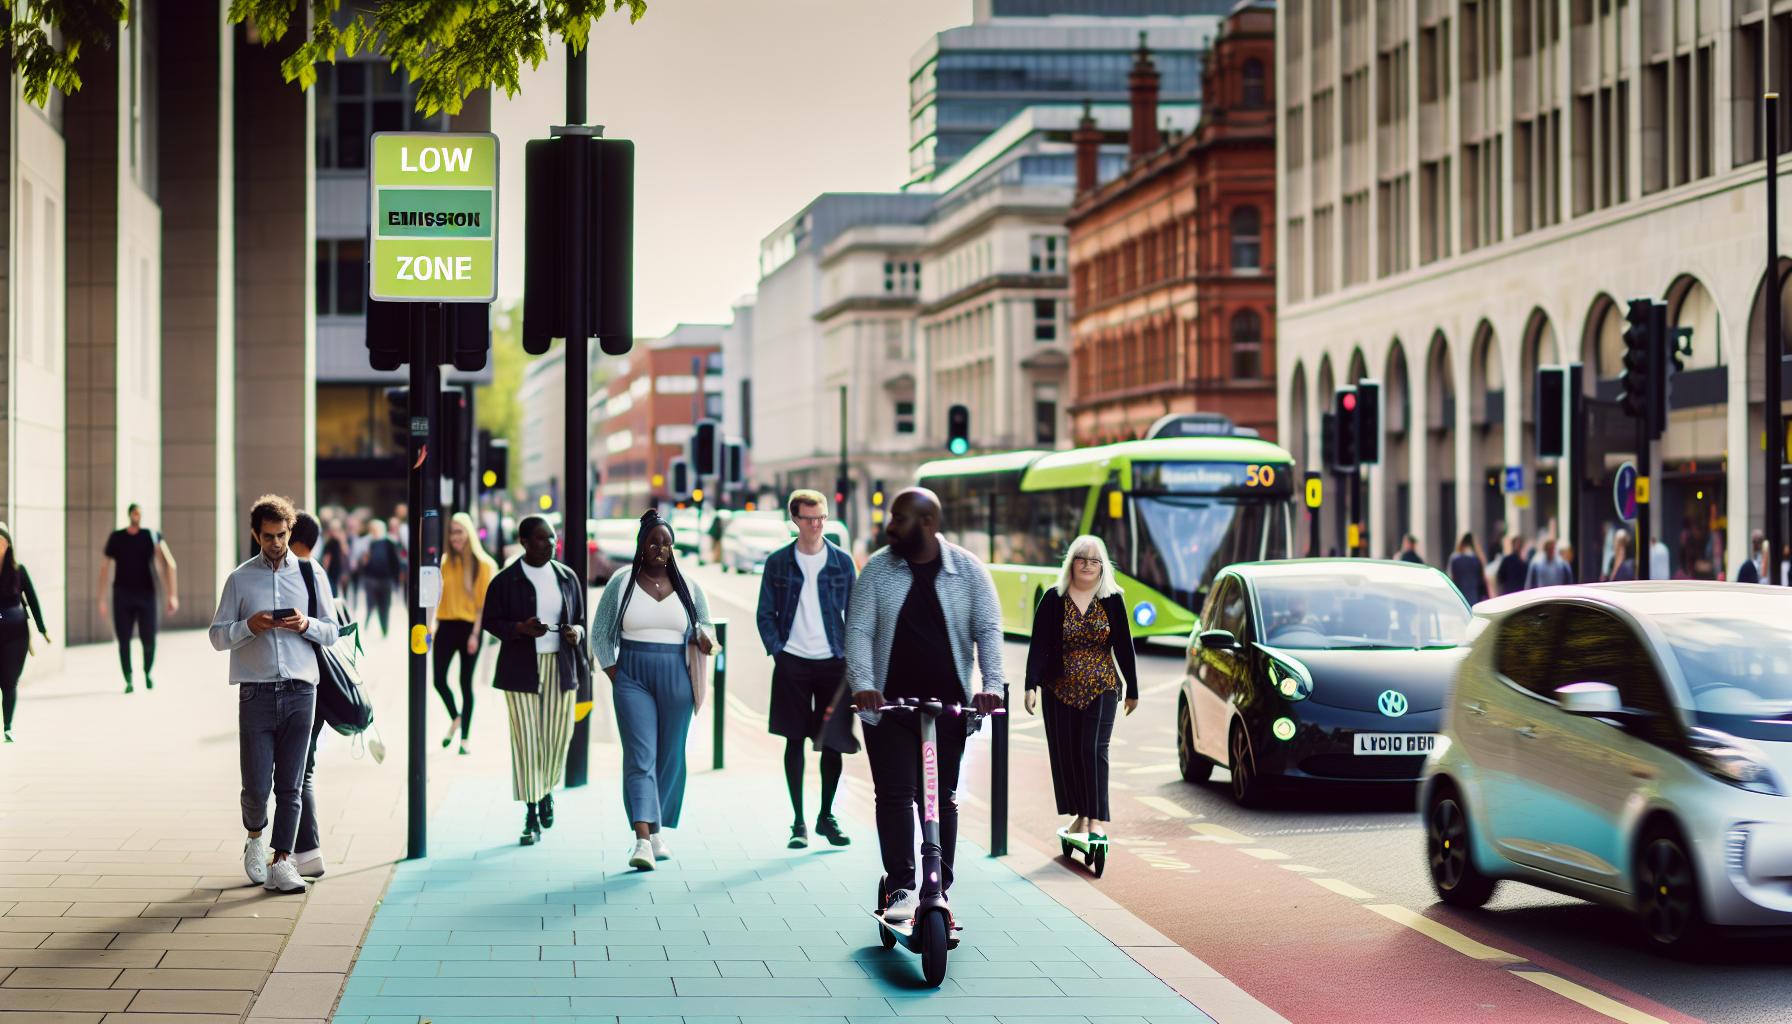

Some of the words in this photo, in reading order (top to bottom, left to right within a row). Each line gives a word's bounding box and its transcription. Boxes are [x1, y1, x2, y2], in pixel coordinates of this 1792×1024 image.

[401, 147, 473, 173] LOW
[388, 211, 481, 227] EMISSION
[396, 256, 472, 281] ZONE
[1246, 465, 1275, 487] 50
